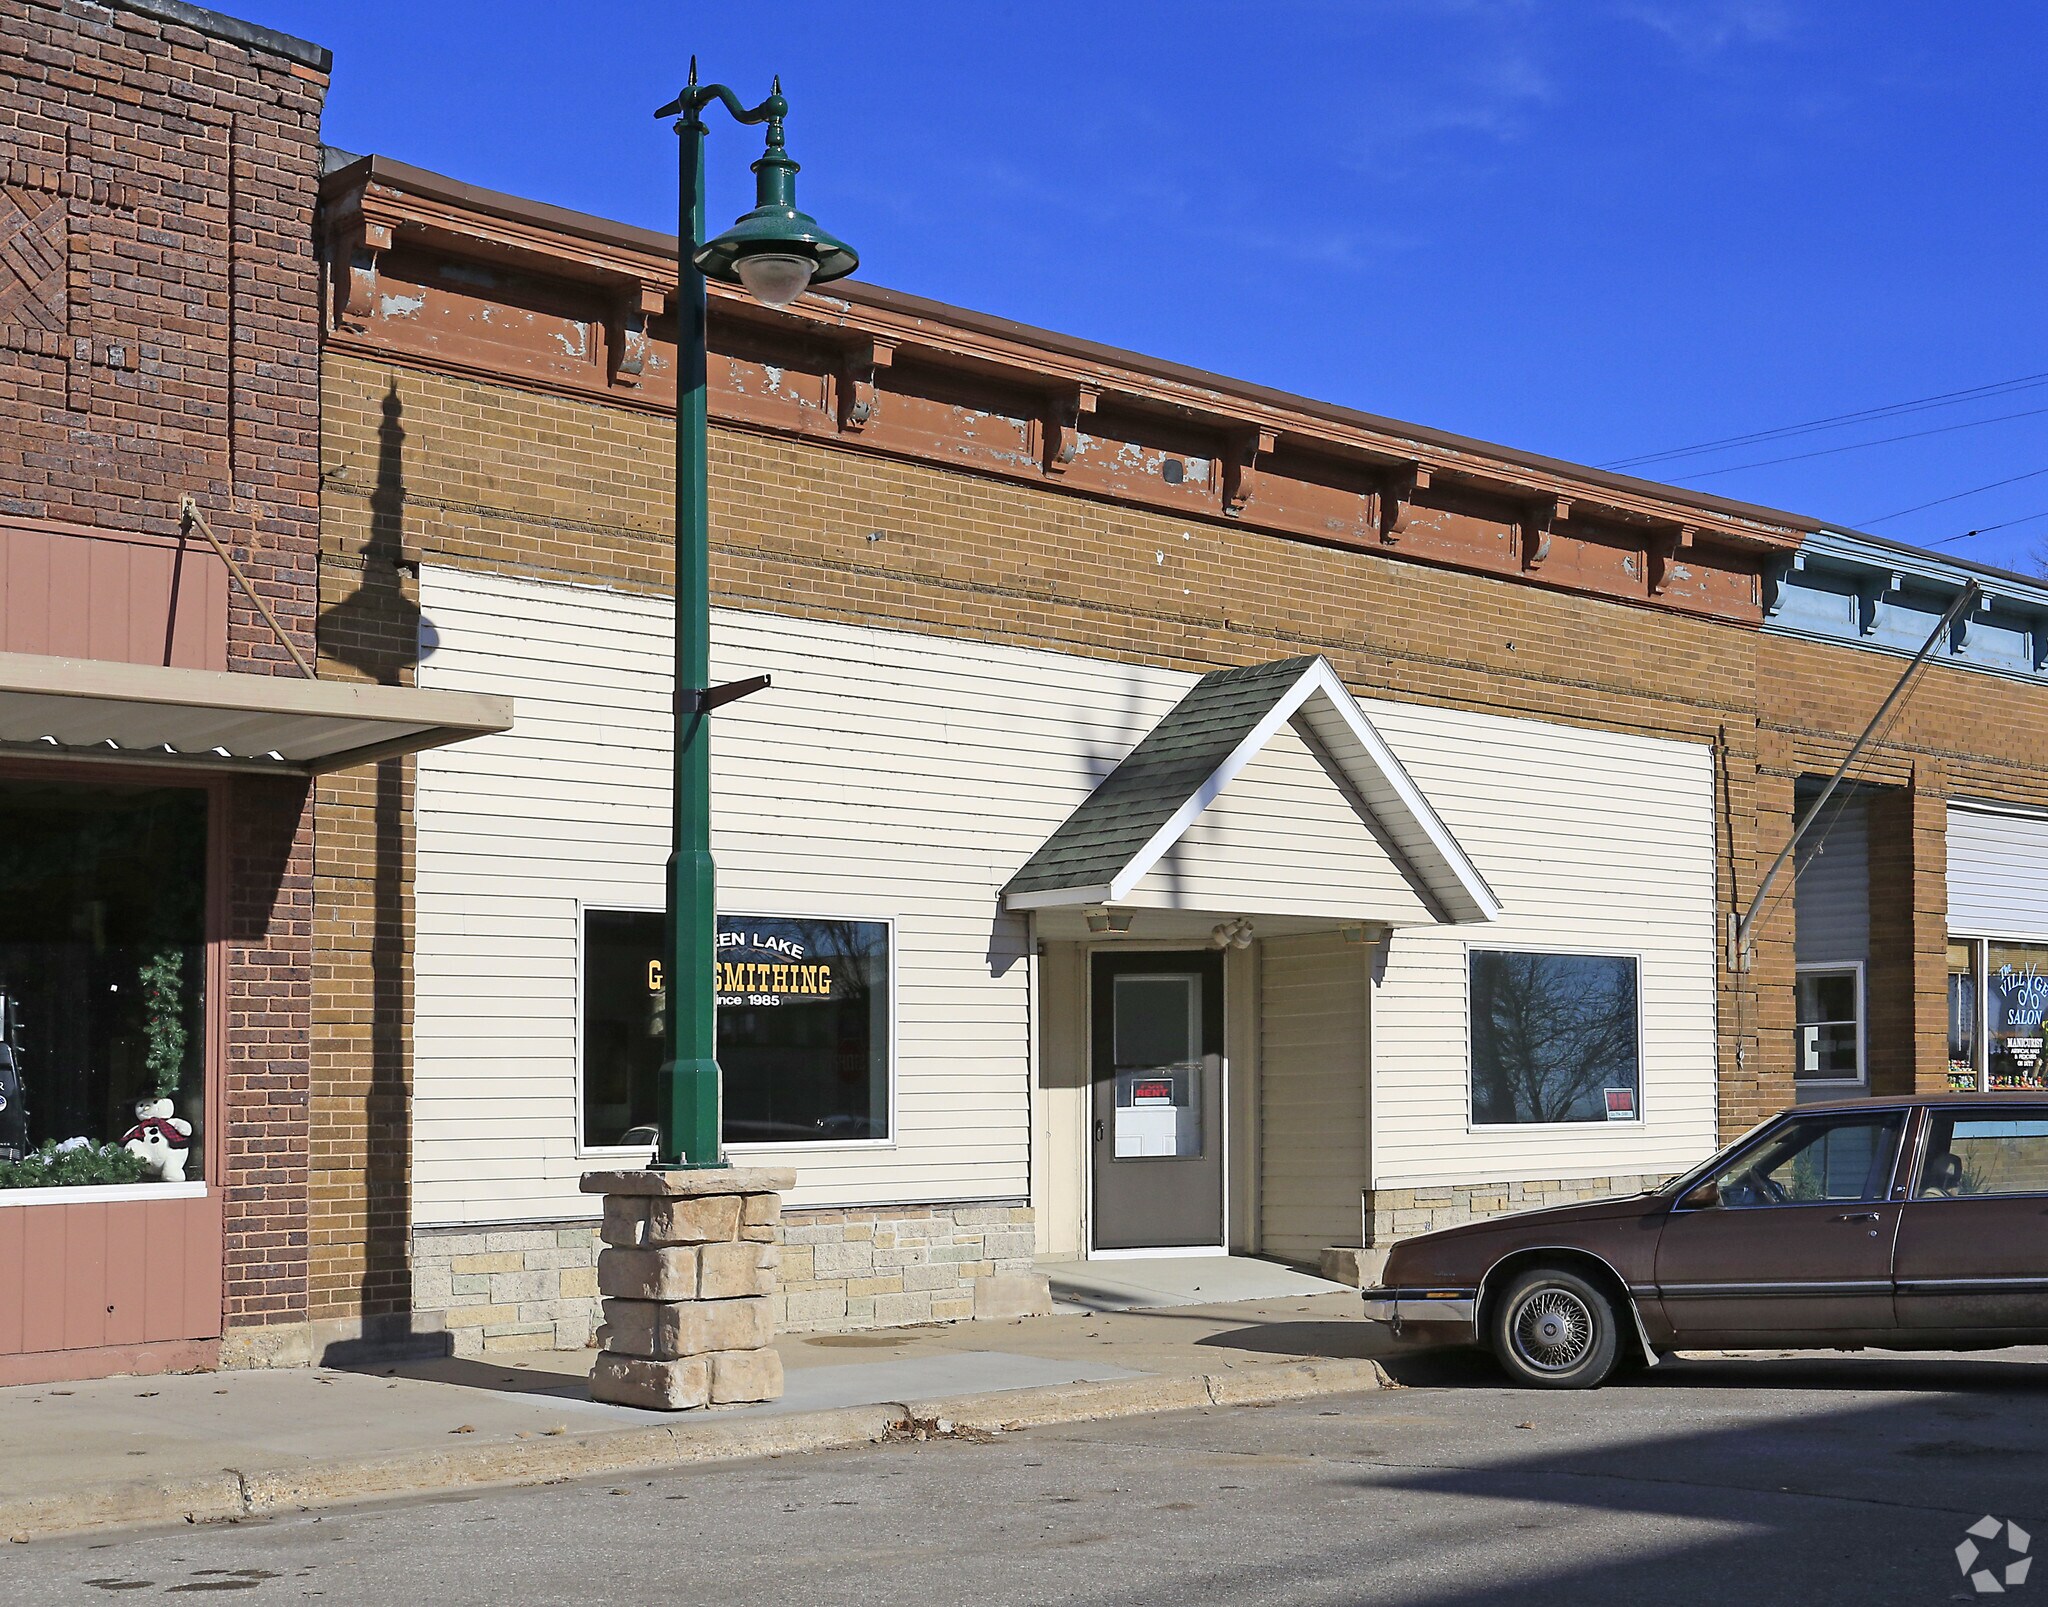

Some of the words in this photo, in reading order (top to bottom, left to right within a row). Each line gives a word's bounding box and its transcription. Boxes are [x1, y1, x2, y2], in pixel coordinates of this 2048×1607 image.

[753, 933, 804, 959] LAKE
[716, 995, 742, 1005] ince
[748, 995, 780, 1006] 1985
[2007, 1009, 2042, 1025] SALON
[1136, 1088, 1169, 1097] RENT
